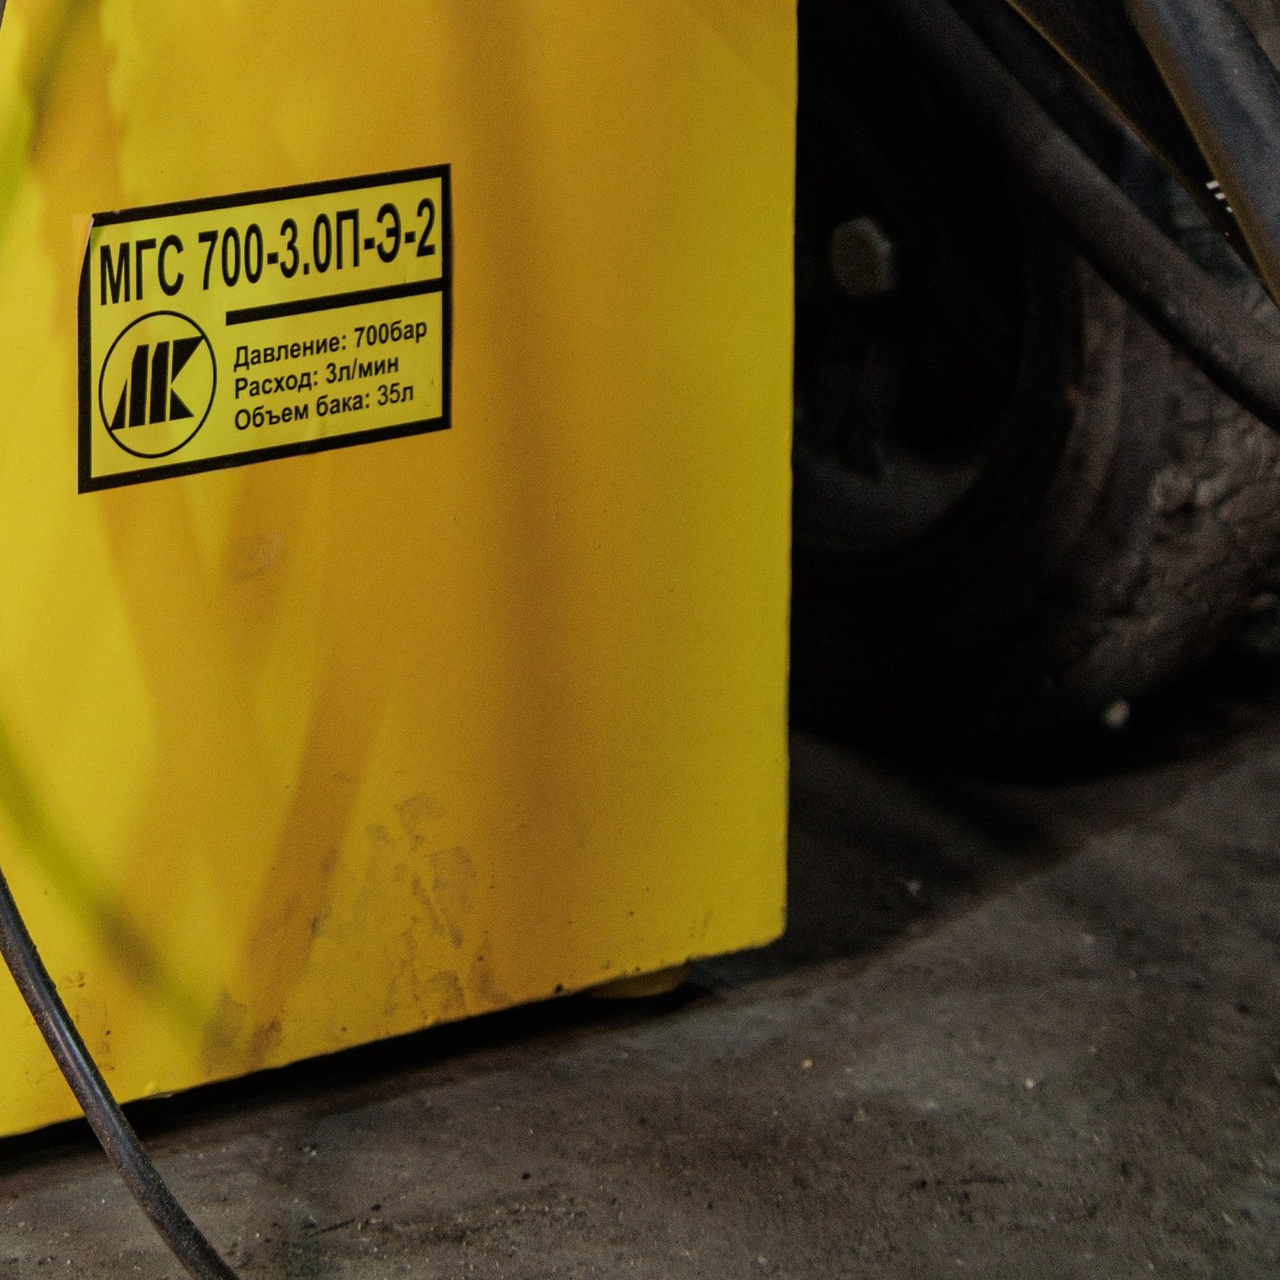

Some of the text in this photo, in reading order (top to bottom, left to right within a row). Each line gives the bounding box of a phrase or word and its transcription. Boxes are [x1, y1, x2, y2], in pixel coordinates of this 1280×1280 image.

[99, 196, 437, 307] МГС 700-3.0П-Э-2
[233, 319, 428, 373] Давление: 700бар
[234, 356, 400, 400] Расход: 3л/мин
[234, 384, 414, 431] Объем бака: 35л
